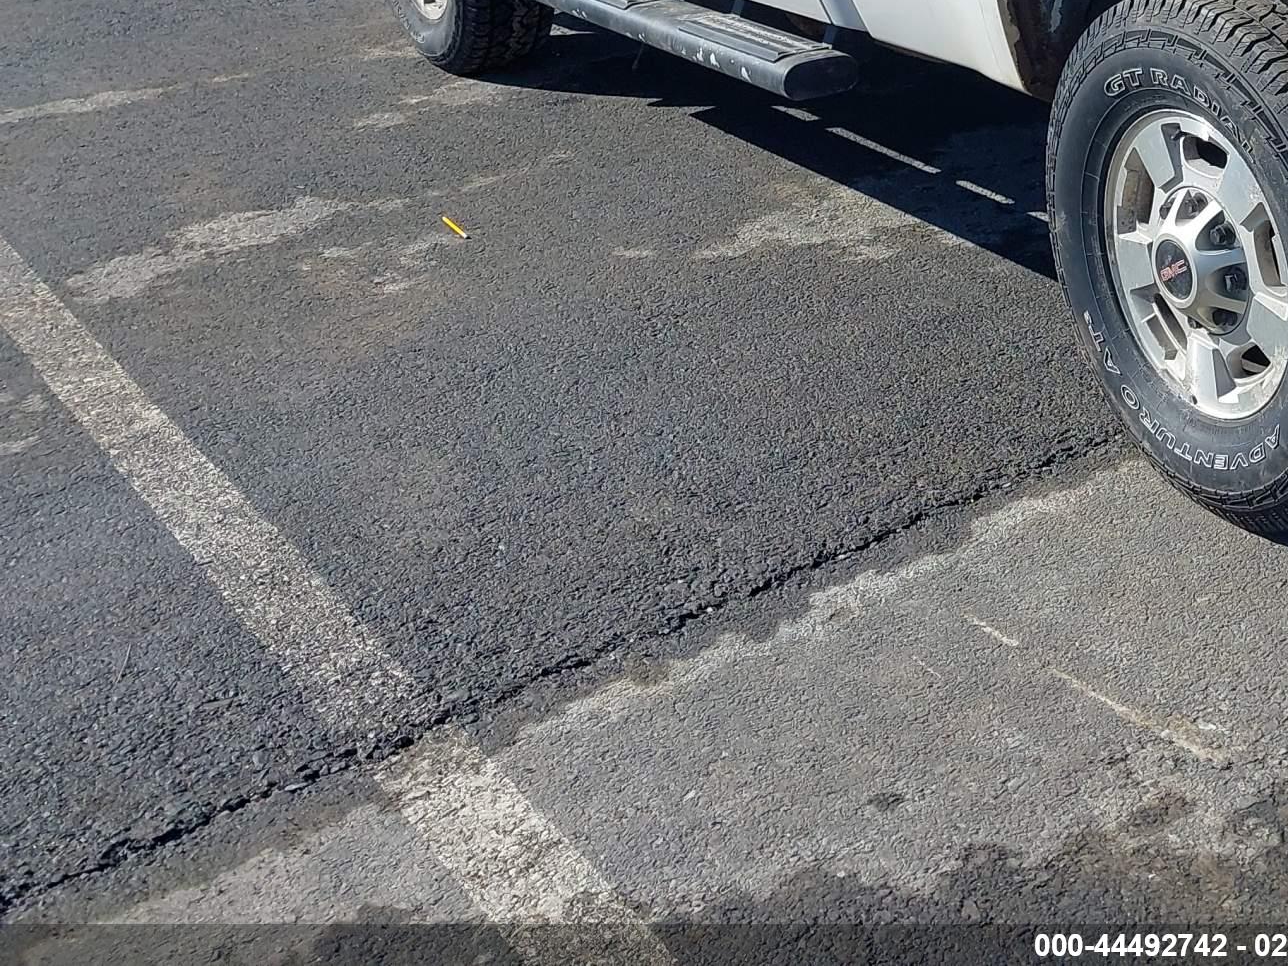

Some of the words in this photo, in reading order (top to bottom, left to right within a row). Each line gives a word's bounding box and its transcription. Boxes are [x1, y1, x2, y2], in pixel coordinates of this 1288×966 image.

[1104, 67, 1142, 96] GT
[1150, 68, 1256, 164] RADIAL
[1160, 259, 1187, 282] GMC
[1121, 384, 1281, 471] ADVENTURO
